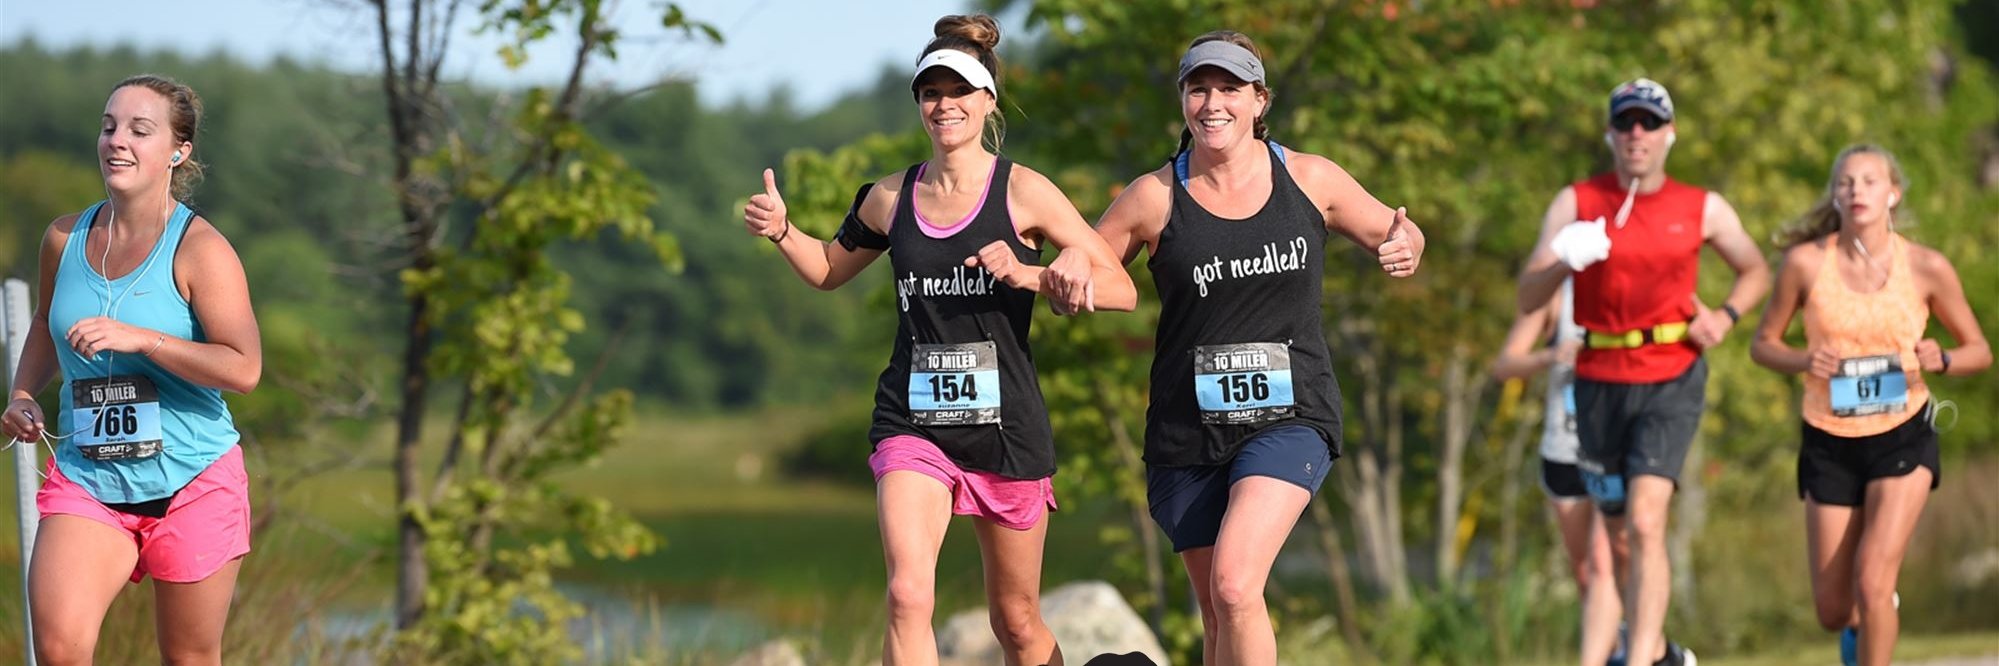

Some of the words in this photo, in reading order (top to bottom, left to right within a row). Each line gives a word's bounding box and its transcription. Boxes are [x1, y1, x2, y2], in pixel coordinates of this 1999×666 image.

[1193, 255, 1223, 298] got
[1230, 236, 1308, 279] needled?
[898, 271, 918, 312] got
[927, 355, 940, 369] 10
[942, 354, 977, 369] MILER
[1213, 356, 1228, 370] 10
[1230, 353, 1268, 369] MILER
[90, 388, 104, 403] 10
[105, 386, 137, 401] MILER
[928, 374, 978, 402] 154
[1217, 373, 1269, 403] 156
[1857, 376, 1881, 402] 67
[92, 405, 138, 438] 766
[935, 410, 965, 418] CRAFT
[1227, 409, 1257, 419] CRAFT
[98, 444, 126, 454] CRAFT
